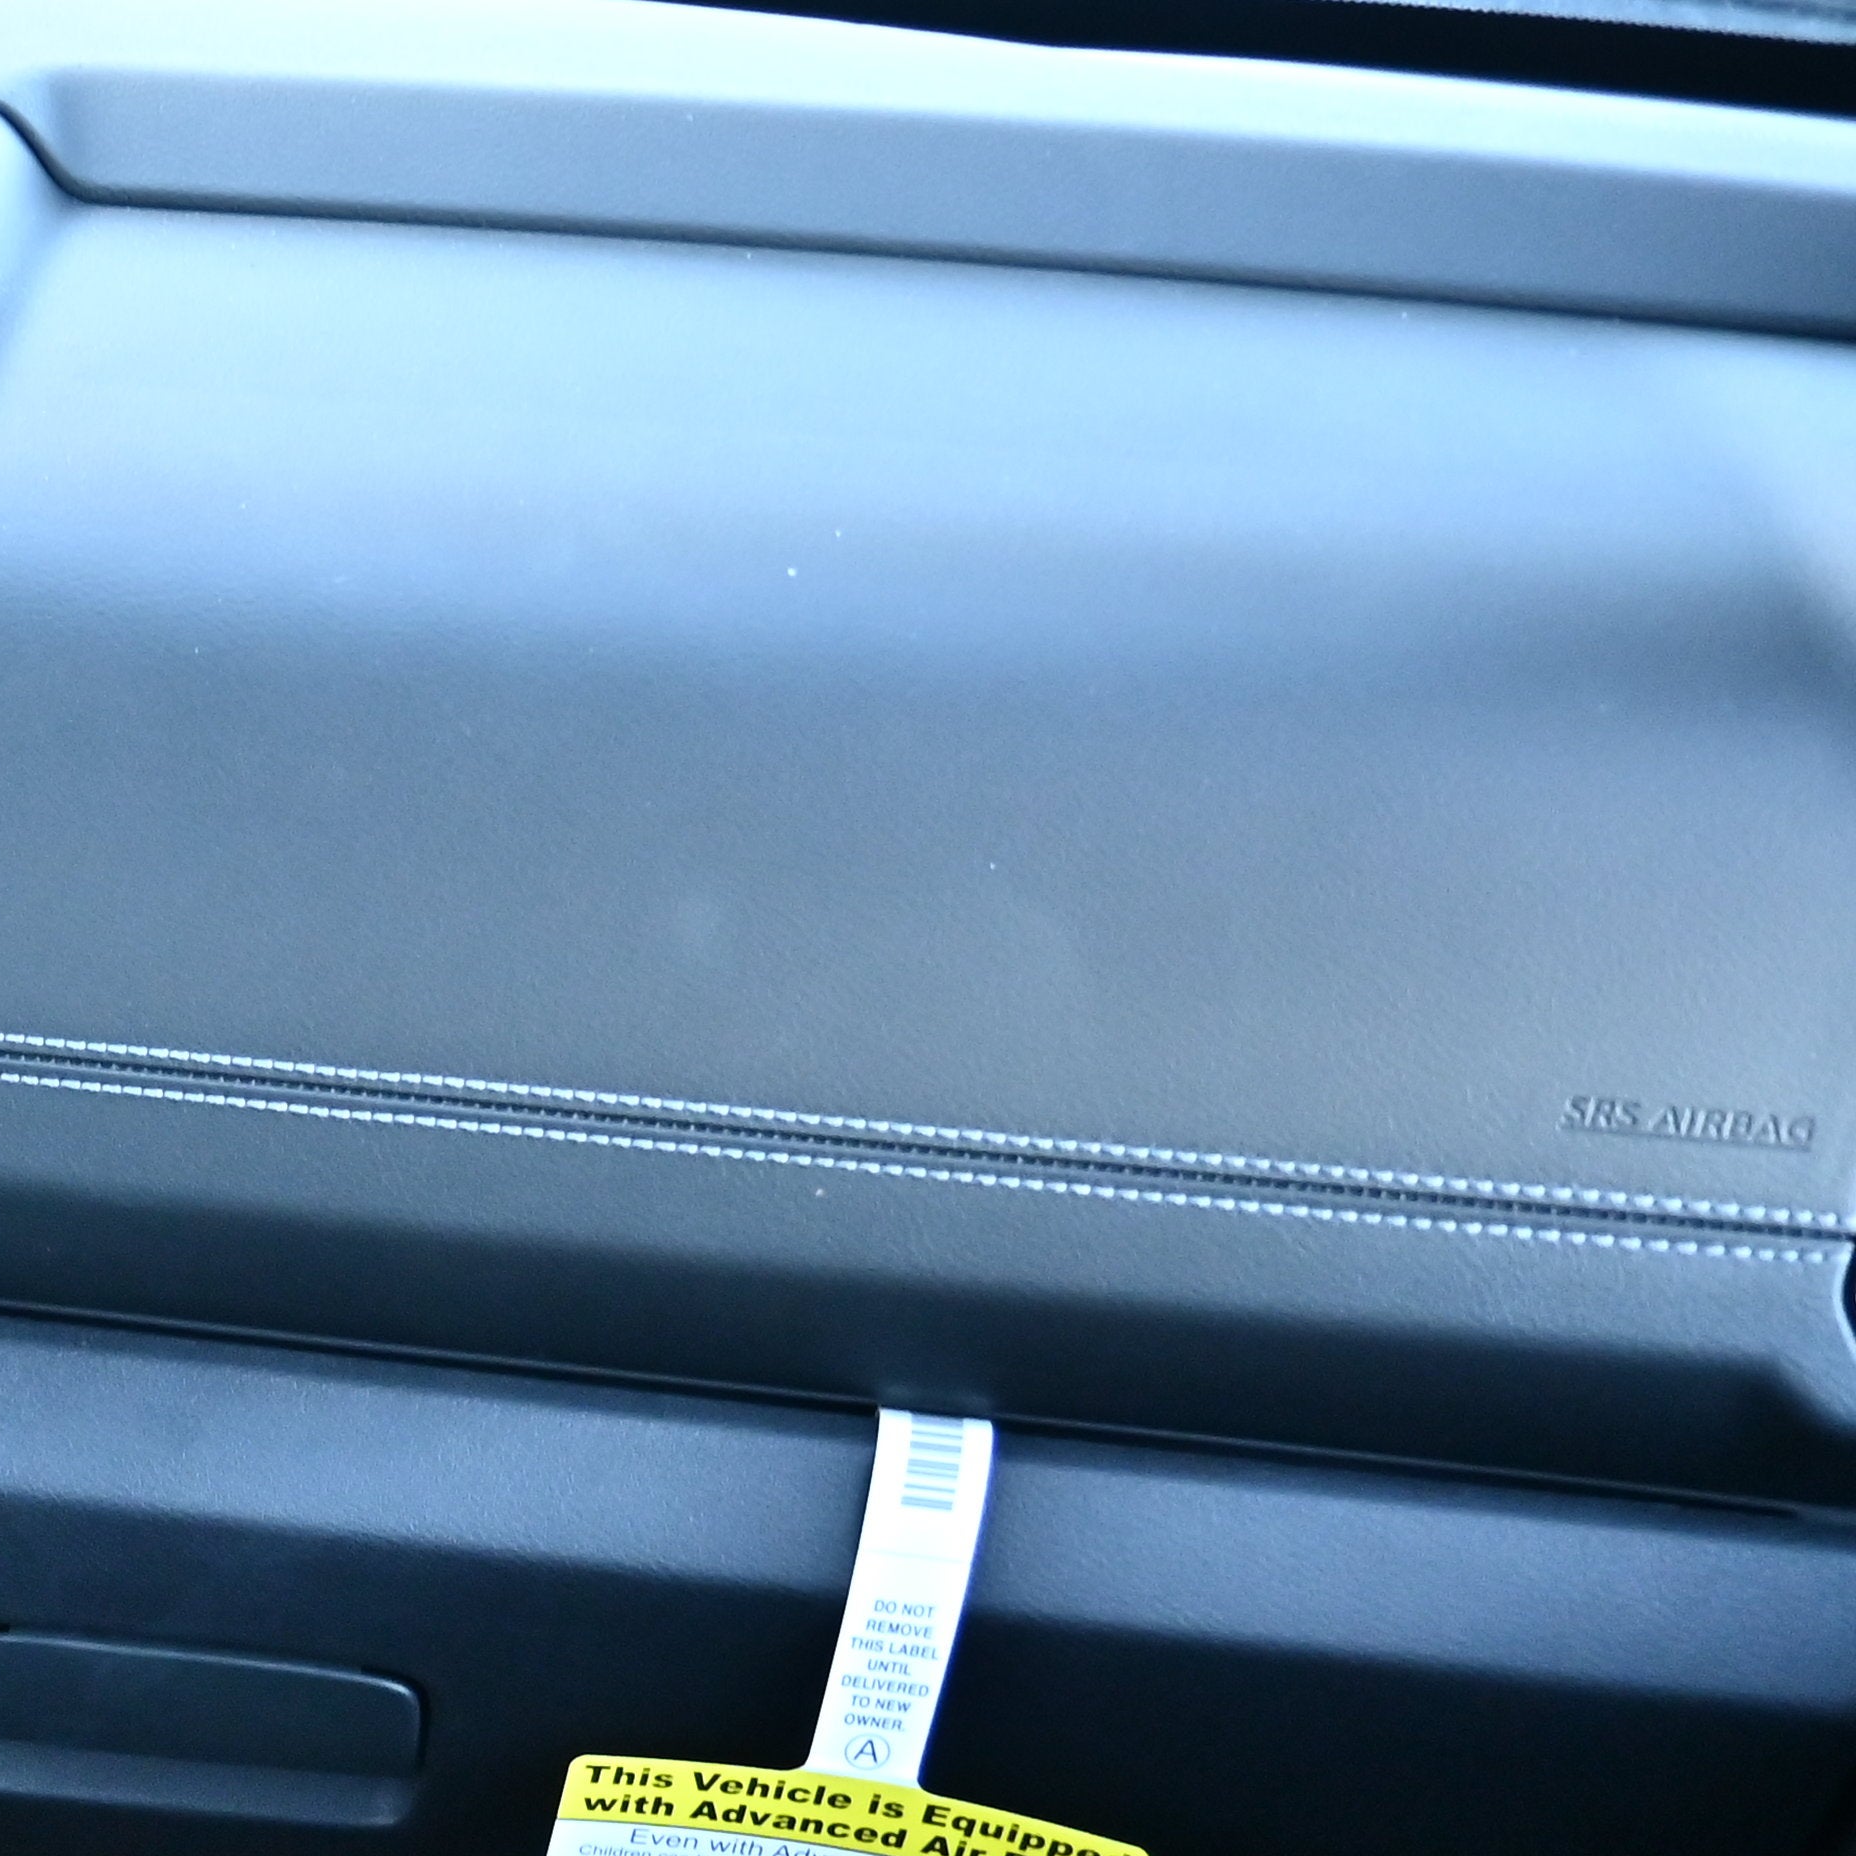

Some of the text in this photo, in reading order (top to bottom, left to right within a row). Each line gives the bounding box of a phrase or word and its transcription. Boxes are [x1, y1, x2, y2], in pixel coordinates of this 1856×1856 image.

[1555, 1094, 1816, 1147] SRS AIRBAG
[874, 1600, 935, 1619] DO NOT
[866, 1618, 934, 1639] REMOVE
[851, 1636, 939, 1660] THIS LABEL
[867, 1658, 912, 1676] UNTIL
[841, 1674, 930, 1698] DELIVERED
[851, 1694, 912, 1714] TO NEW
[844, 1712, 906, 1732] OWNER.
[853, 1738, 878, 1764] A
[585, 1764, 674, 1789] This
[693, 1771, 852, 1810] Vehicle
[868, 1793, 905, 1819] is
[584, 1794, 675, 1817] with
[689, 1800, 908, 1849] Advanced
[630, 1827, 699, 1850] Even
